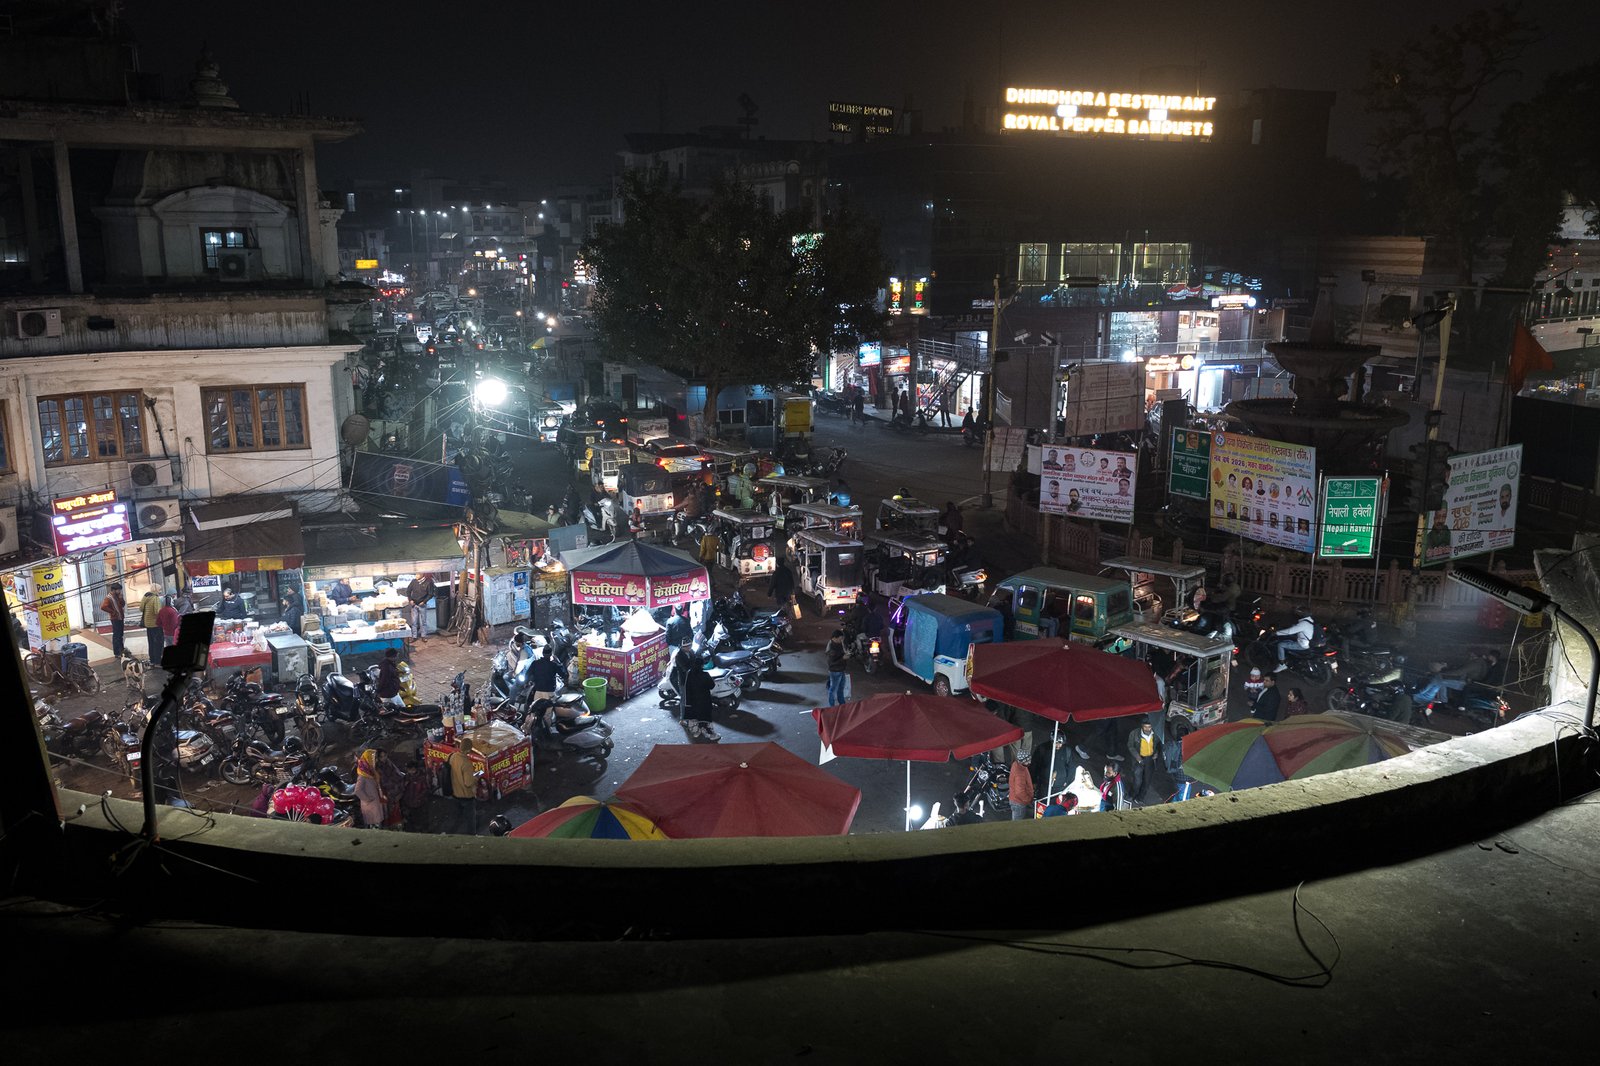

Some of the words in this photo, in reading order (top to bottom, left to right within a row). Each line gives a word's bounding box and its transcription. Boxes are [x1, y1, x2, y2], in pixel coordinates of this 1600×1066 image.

[1006, 87, 1106, 107] DHINDHORA
[1109, 92, 1217, 111] RESTAURANT
[1003, 114, 1060, 131] ROYAL
[1063, 116, 1126, 134] PEPPER
[1127, 120, 1214, 136] BANQUETS
[1328, 503, 1350, 518] नेपाली
[1351, 503, 1372, 519] हवेली
[1326, 522, 1348, 535] Nepali
[1349, 522, 1371, 533] Haveli
[579, 582, 625, 597] केसरिया
[653, 582, 690, 598] केसरिया
